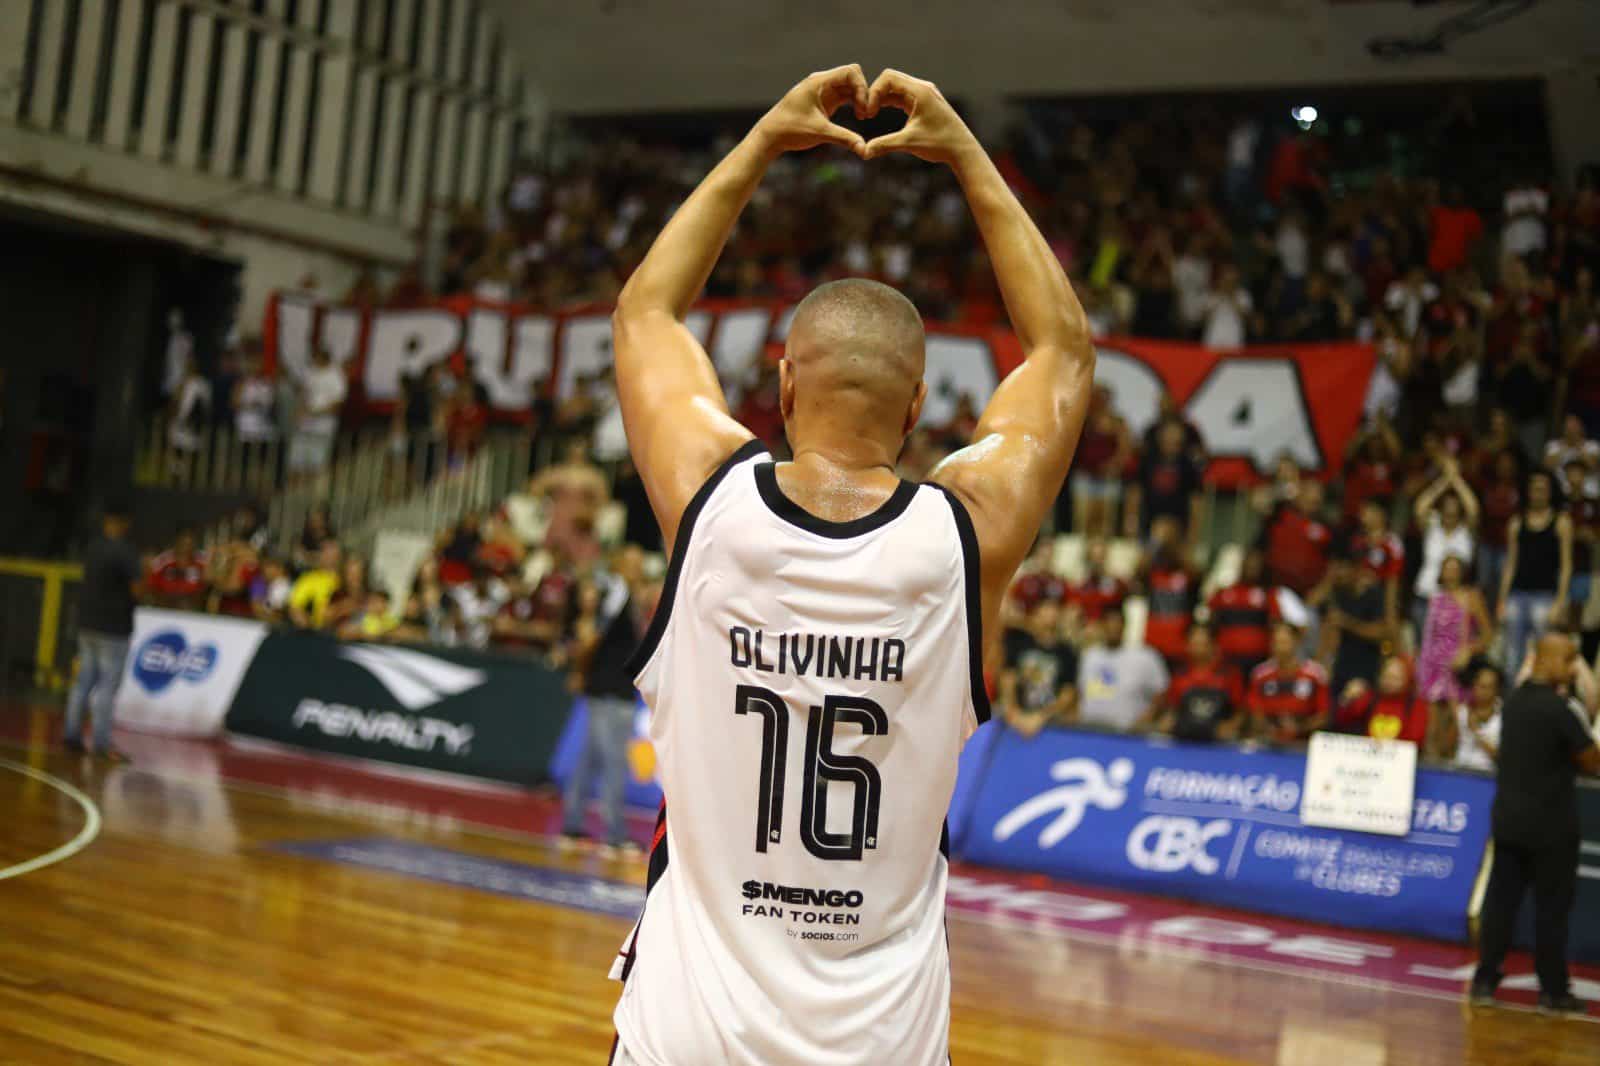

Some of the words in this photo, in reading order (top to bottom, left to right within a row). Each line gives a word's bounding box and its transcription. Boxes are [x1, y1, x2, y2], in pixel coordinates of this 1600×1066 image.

[730, 626, 905, 682] OLIVINHA
[292, 697, 475, 757] PENALTY
[735, 684, 889, 861] 16
[1144, 764, 1301, 813] FORMAÇÃO
[1125, 814, 1232, 877] CBC
[742, 880, 864, 908] $MENGO
[742, 904, 783, 918] FAN
[790, 910, 860, 925] TOKEN
[786, 928, 798, 939] by
